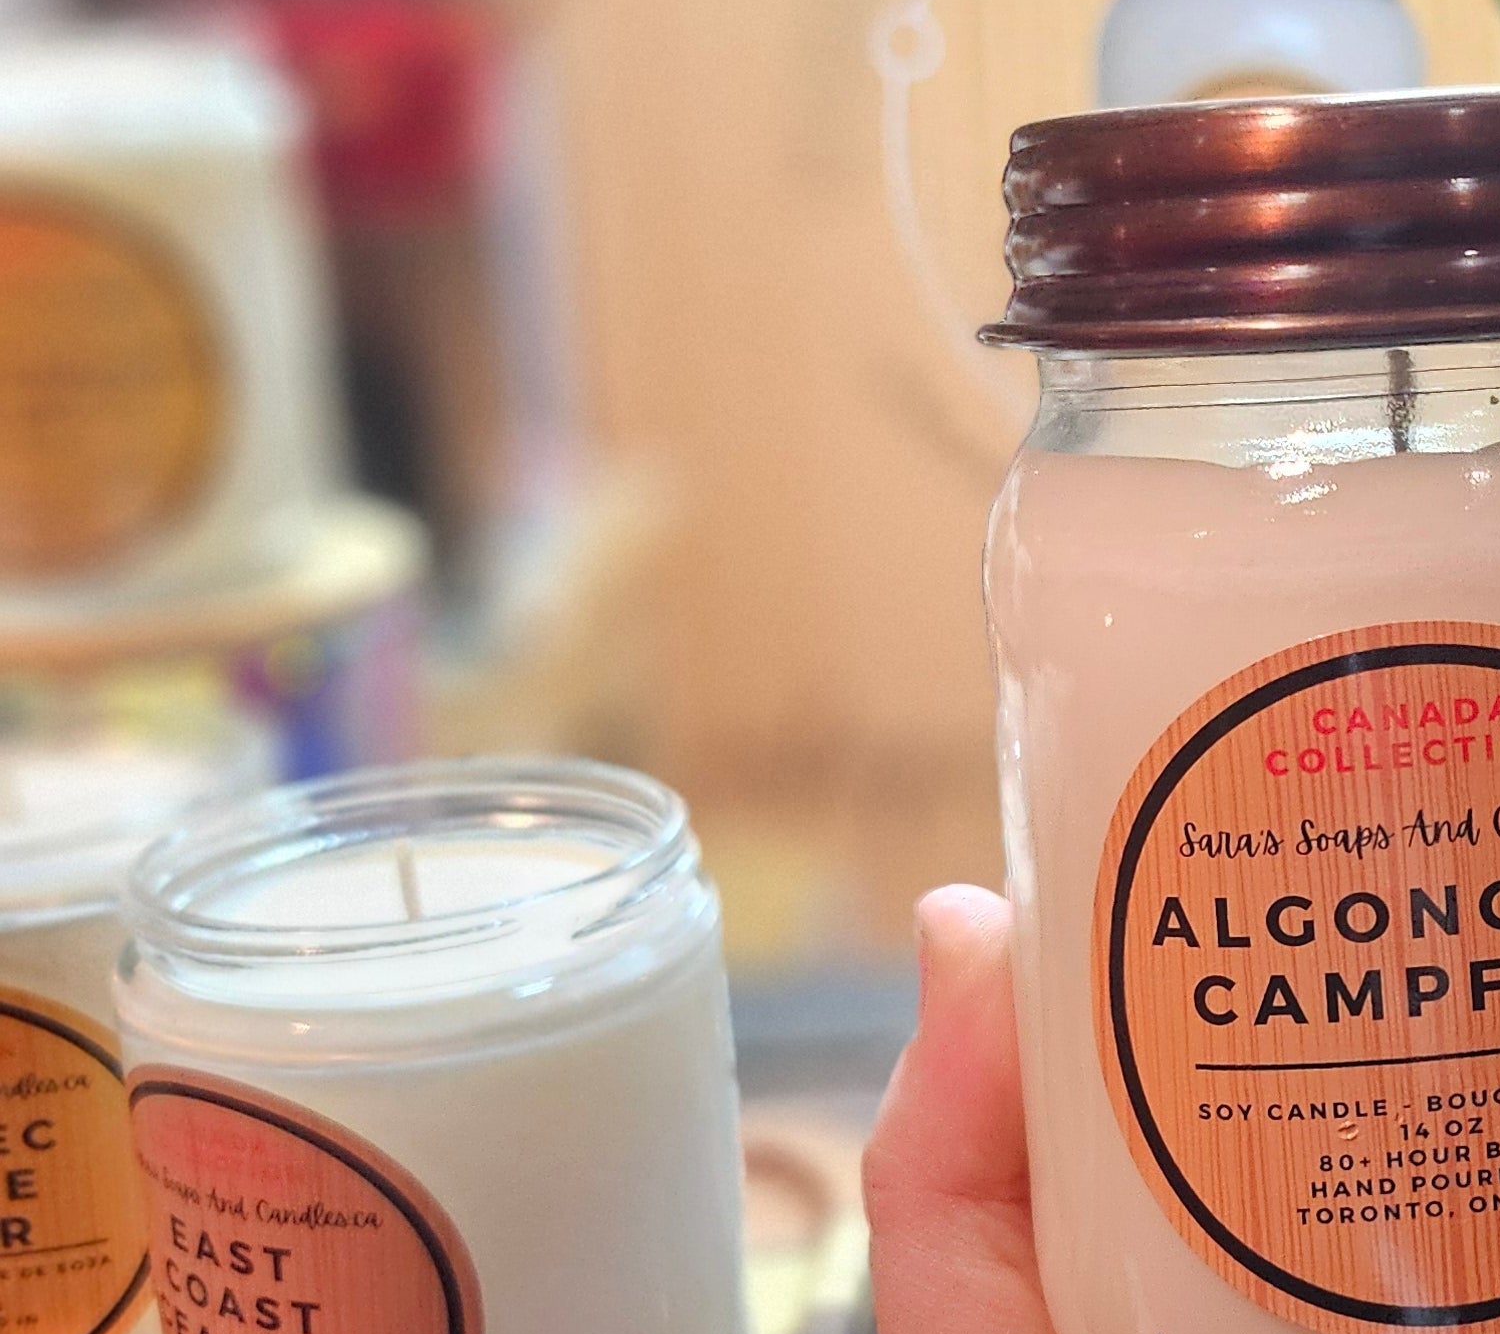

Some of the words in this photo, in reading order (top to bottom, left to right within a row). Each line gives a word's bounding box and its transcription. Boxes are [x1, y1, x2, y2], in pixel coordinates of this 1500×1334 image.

[1179, 821, 1284, 860] Sara's
[1295, 817, 1394, 860] Soaps
[1401, 808, 1481, 848] And
[1198, 1102, 1253, 1121] SOY
[1267, 1098, 1389, 1121] CANDLE
[1399, 1121, 1430, 1143] 14
[1444, 1116, 1485, 1137] OZ
[1319, 1152, 1373, 1173] 80+
[1386, 1144, 1471, 1169] HOUR
[1310, 1176, 1397, 1199] HAND
[1296, 1200, 1456, 1226] TORONTO,
[170, 1214, 292, 1282] EAST
[166, 1258, 320, 1334] COAST
